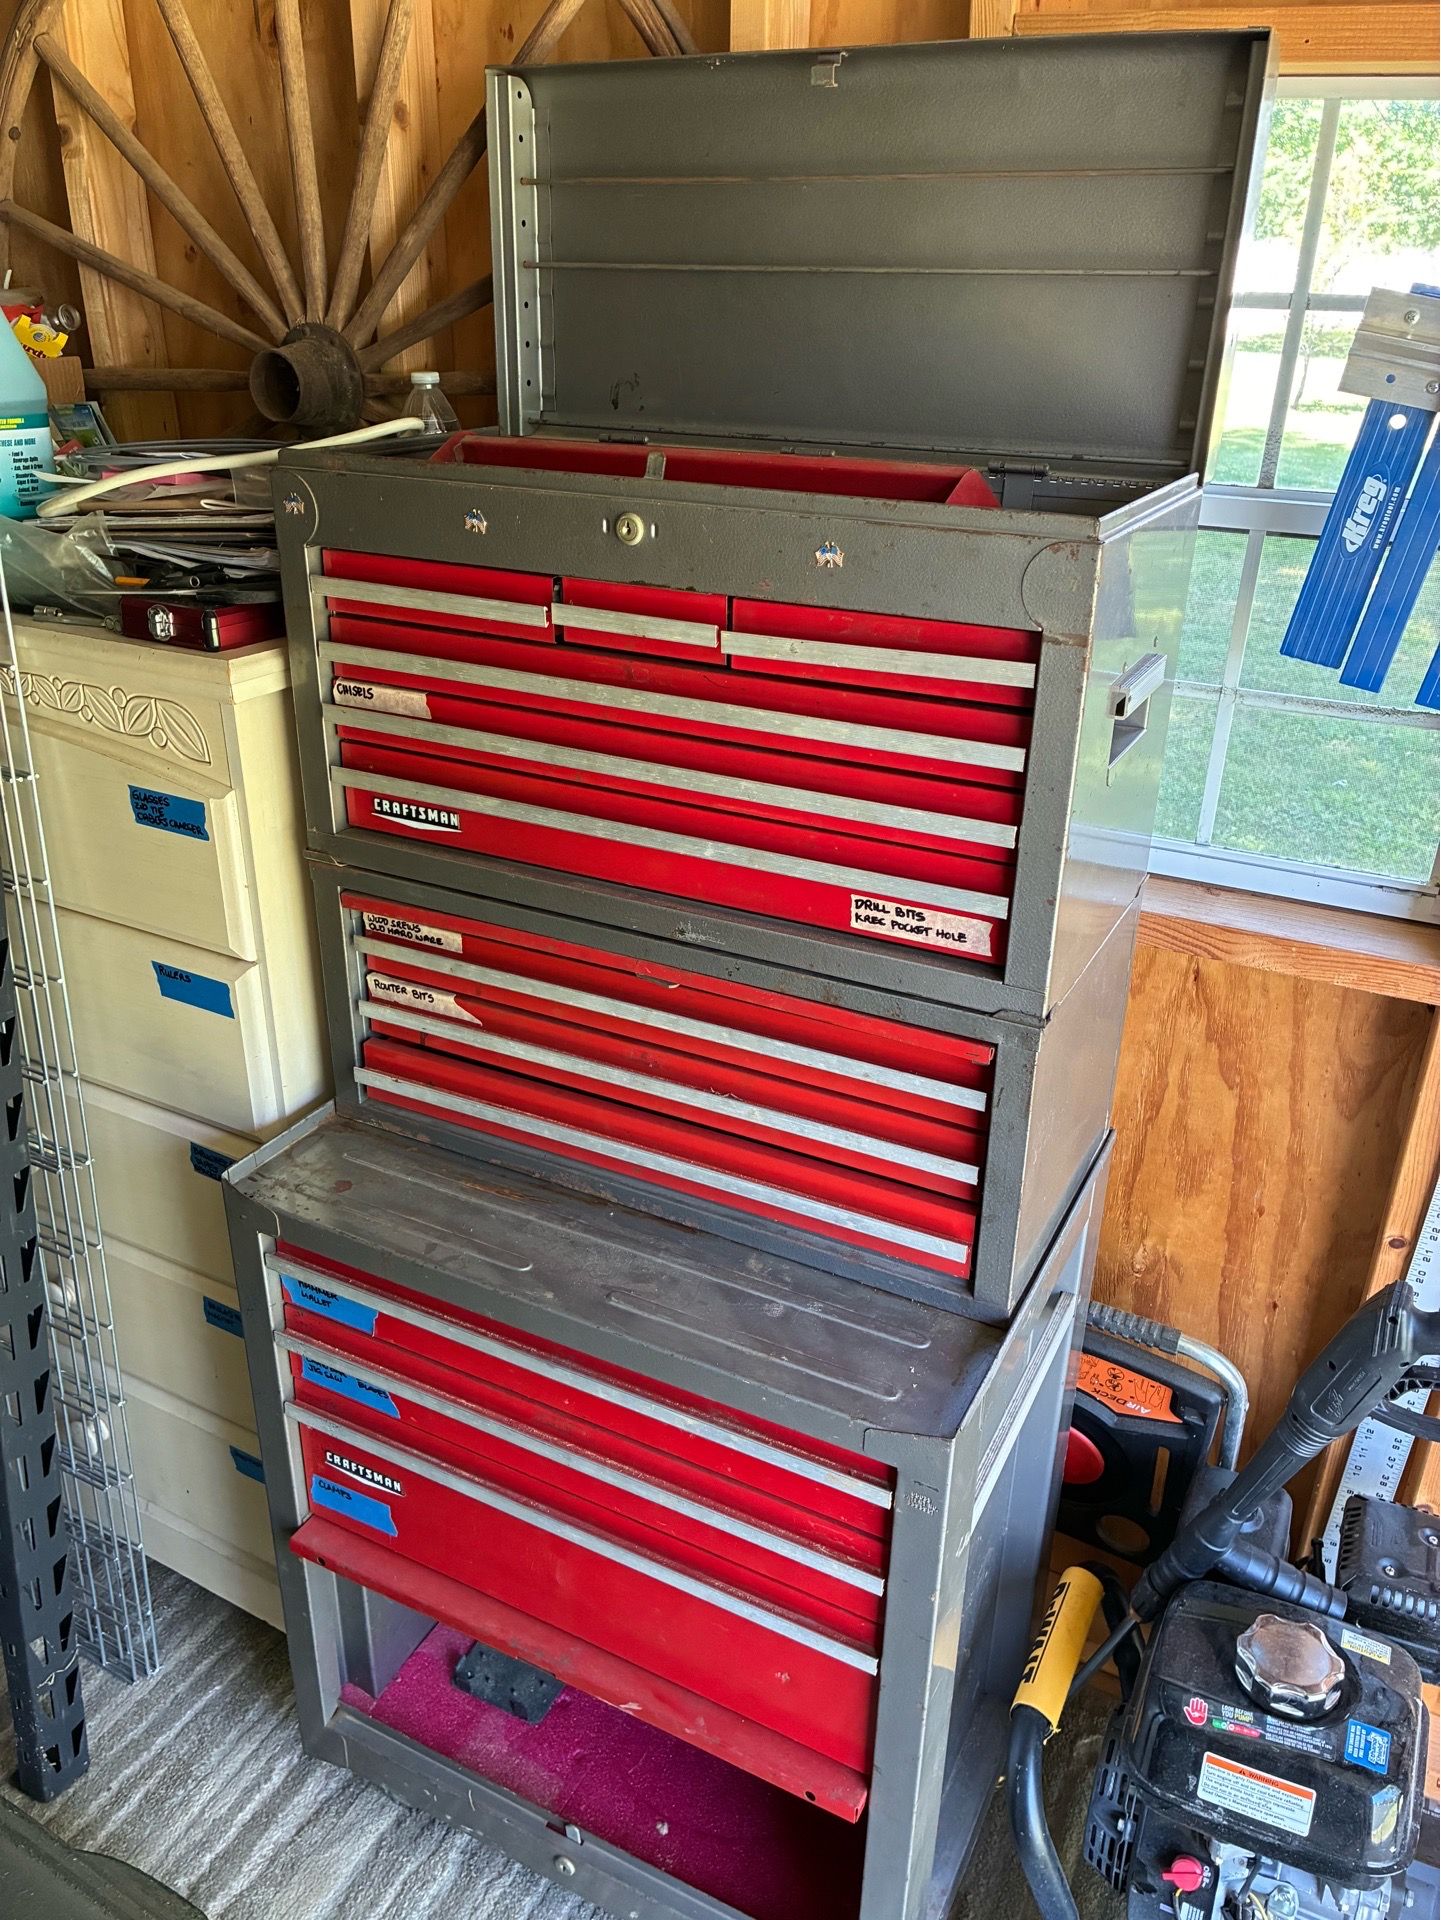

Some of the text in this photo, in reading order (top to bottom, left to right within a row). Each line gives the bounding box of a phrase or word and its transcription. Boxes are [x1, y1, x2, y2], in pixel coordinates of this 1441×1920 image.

[374, 798, 458, 826] CRAFTSMAN
[854, 899, 926, 922] DRILL BITS
[387, 927, 413, 939] HARD
[890, 920, 932, 936] POCKET
[936, 928, 968, 943] HOLE
[374, 979, 434, 1003] ROUTER BITS
[1091, 1388, 1151, 1415] AIRDECK
[326, 1451, 401, 1492] CRAFTSMAN
[1248, 1771, 1280, 1787] WARNING
